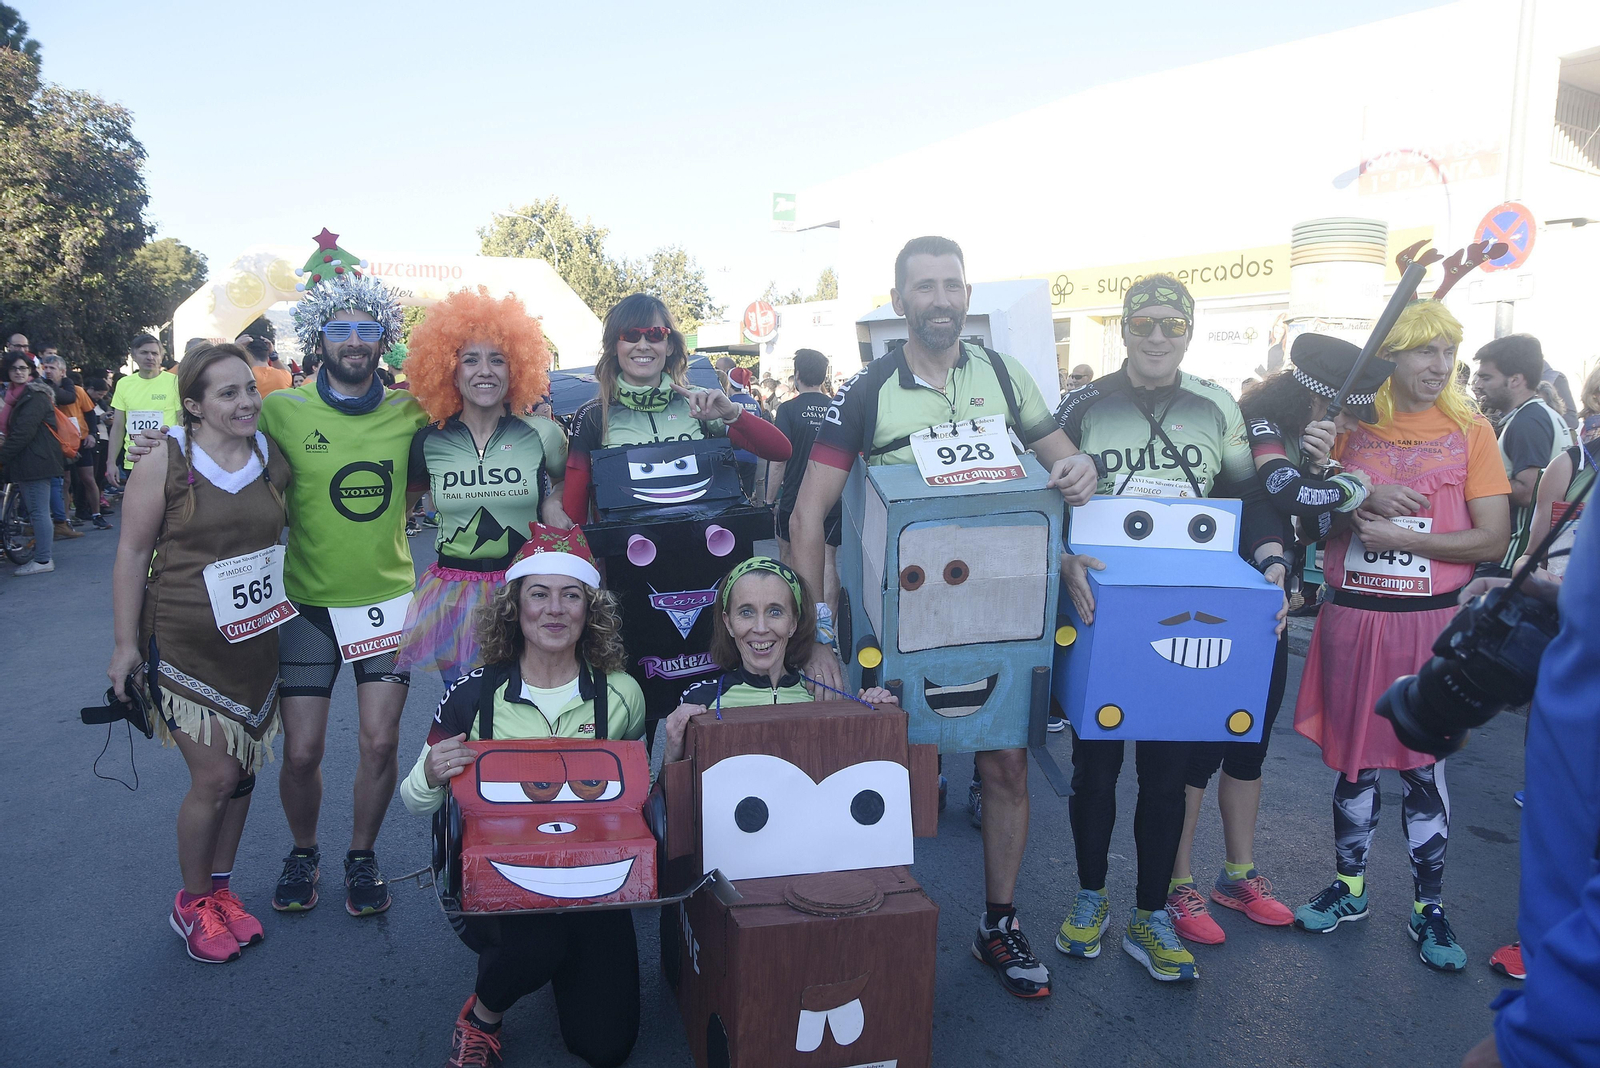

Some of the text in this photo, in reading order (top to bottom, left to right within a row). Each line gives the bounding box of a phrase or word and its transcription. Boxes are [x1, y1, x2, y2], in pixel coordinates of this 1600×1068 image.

[1396, 159, 1485, 190] PLANTA
[359, 262, 463, 281] uzcampo
[1080, 389, 1100, 401] CLUB
[132, 420, 159, 430] 1202
[937, 443, 995, 466] 928
[933, 468, 1007, 485] Cruzcampo
[340, 487, 384, 496] VOLVO
[442, 488, 529, 500] TRAIL RUNNING CLUB
[225, 564, 253, 577] IMDECO
[232, 574, 273, 610] 565
[657, 595, 710, 606] Cars
[226, 609, 281, 637] Cruzcampo
[367, 606, 385, 628] 9
[549, 823, 562, 832] 1
